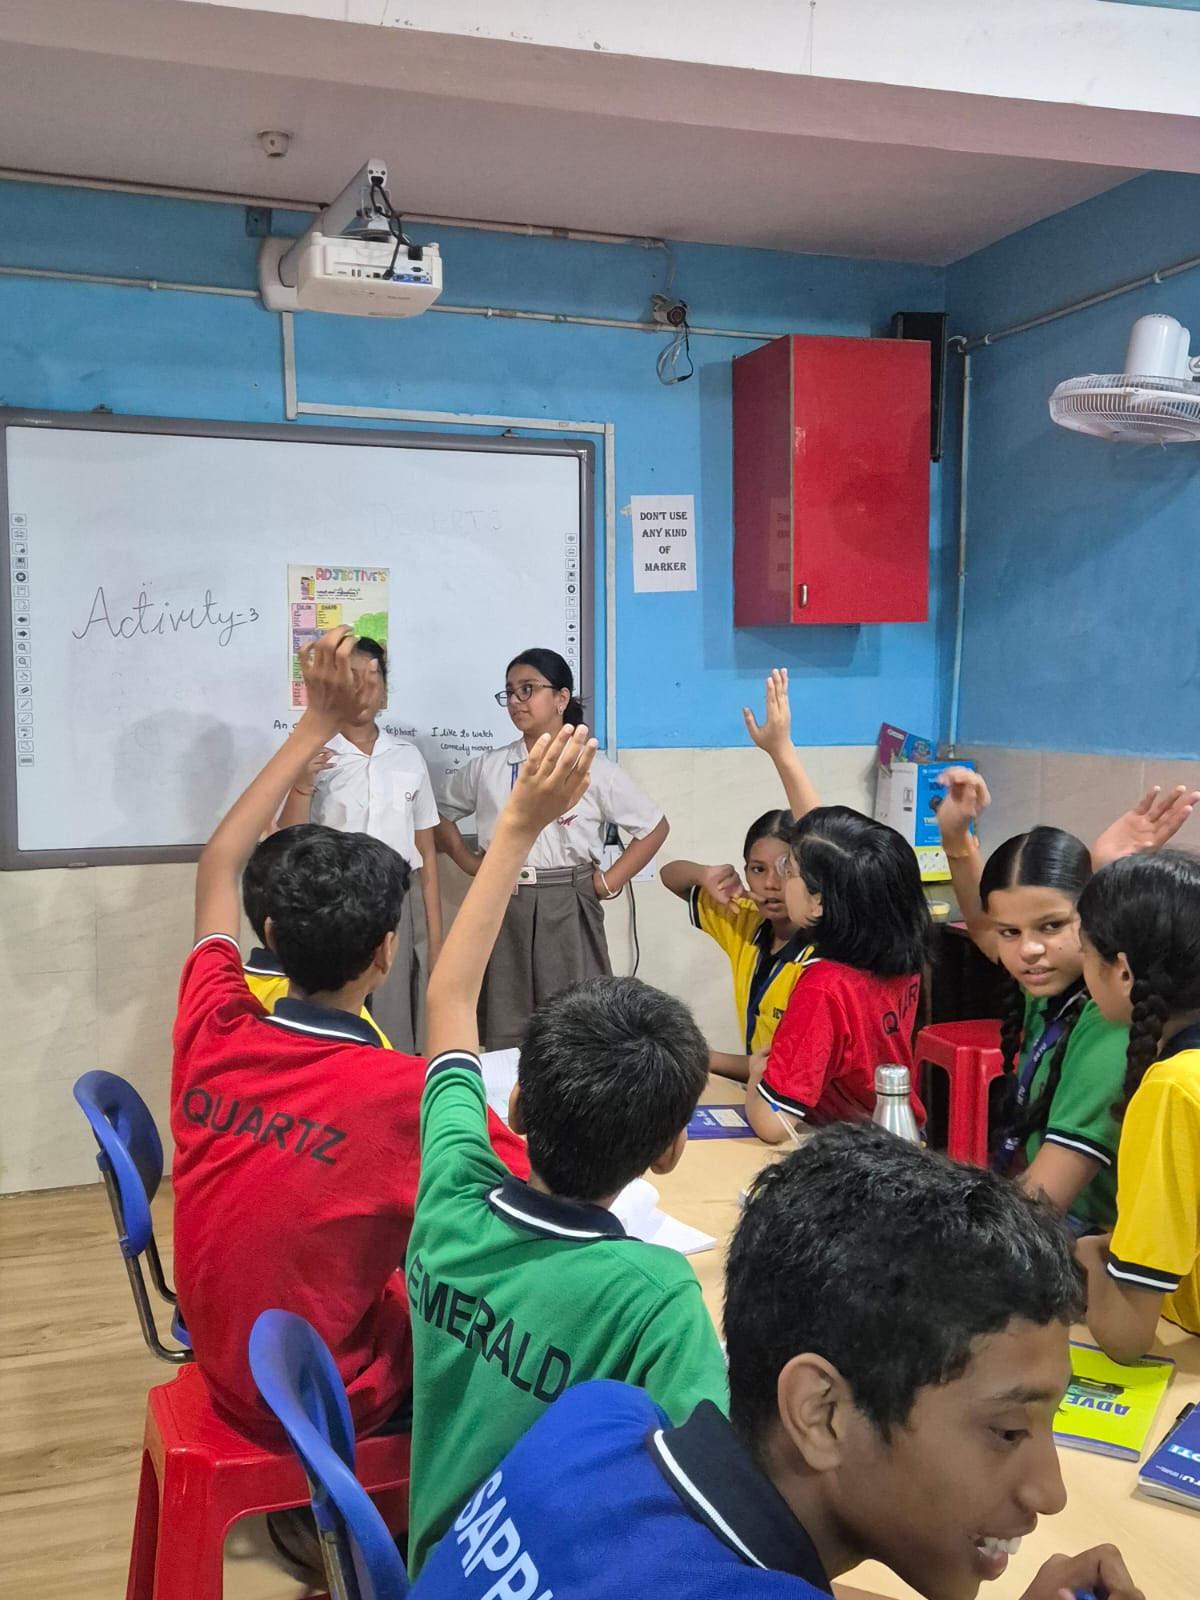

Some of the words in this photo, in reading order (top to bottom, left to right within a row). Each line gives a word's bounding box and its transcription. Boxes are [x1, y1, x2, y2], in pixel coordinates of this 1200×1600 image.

[640, 511, 667, 521] DON'T
[669, 511, 688, 520] USE
[642, 528, 663, 538] ANY
[665, 528, 688, 537] KIND
[658, 545, 672, 555] OF
[644, 562, 687, 572] MARKER
[273, 719, 288, 730] An
[431, 726, 439, 737] I
[440, 728, 458, 737] like
[460, 728, 470, 738] to
[471, 729, 494, 738] watch
[440, 743, 470, 757] comedy
[183, 1087, 347, 1166] QUARTZ
[407, 1253, 572, 1404] EMERALD
[454, 1470, 554, 1600] SAPP
